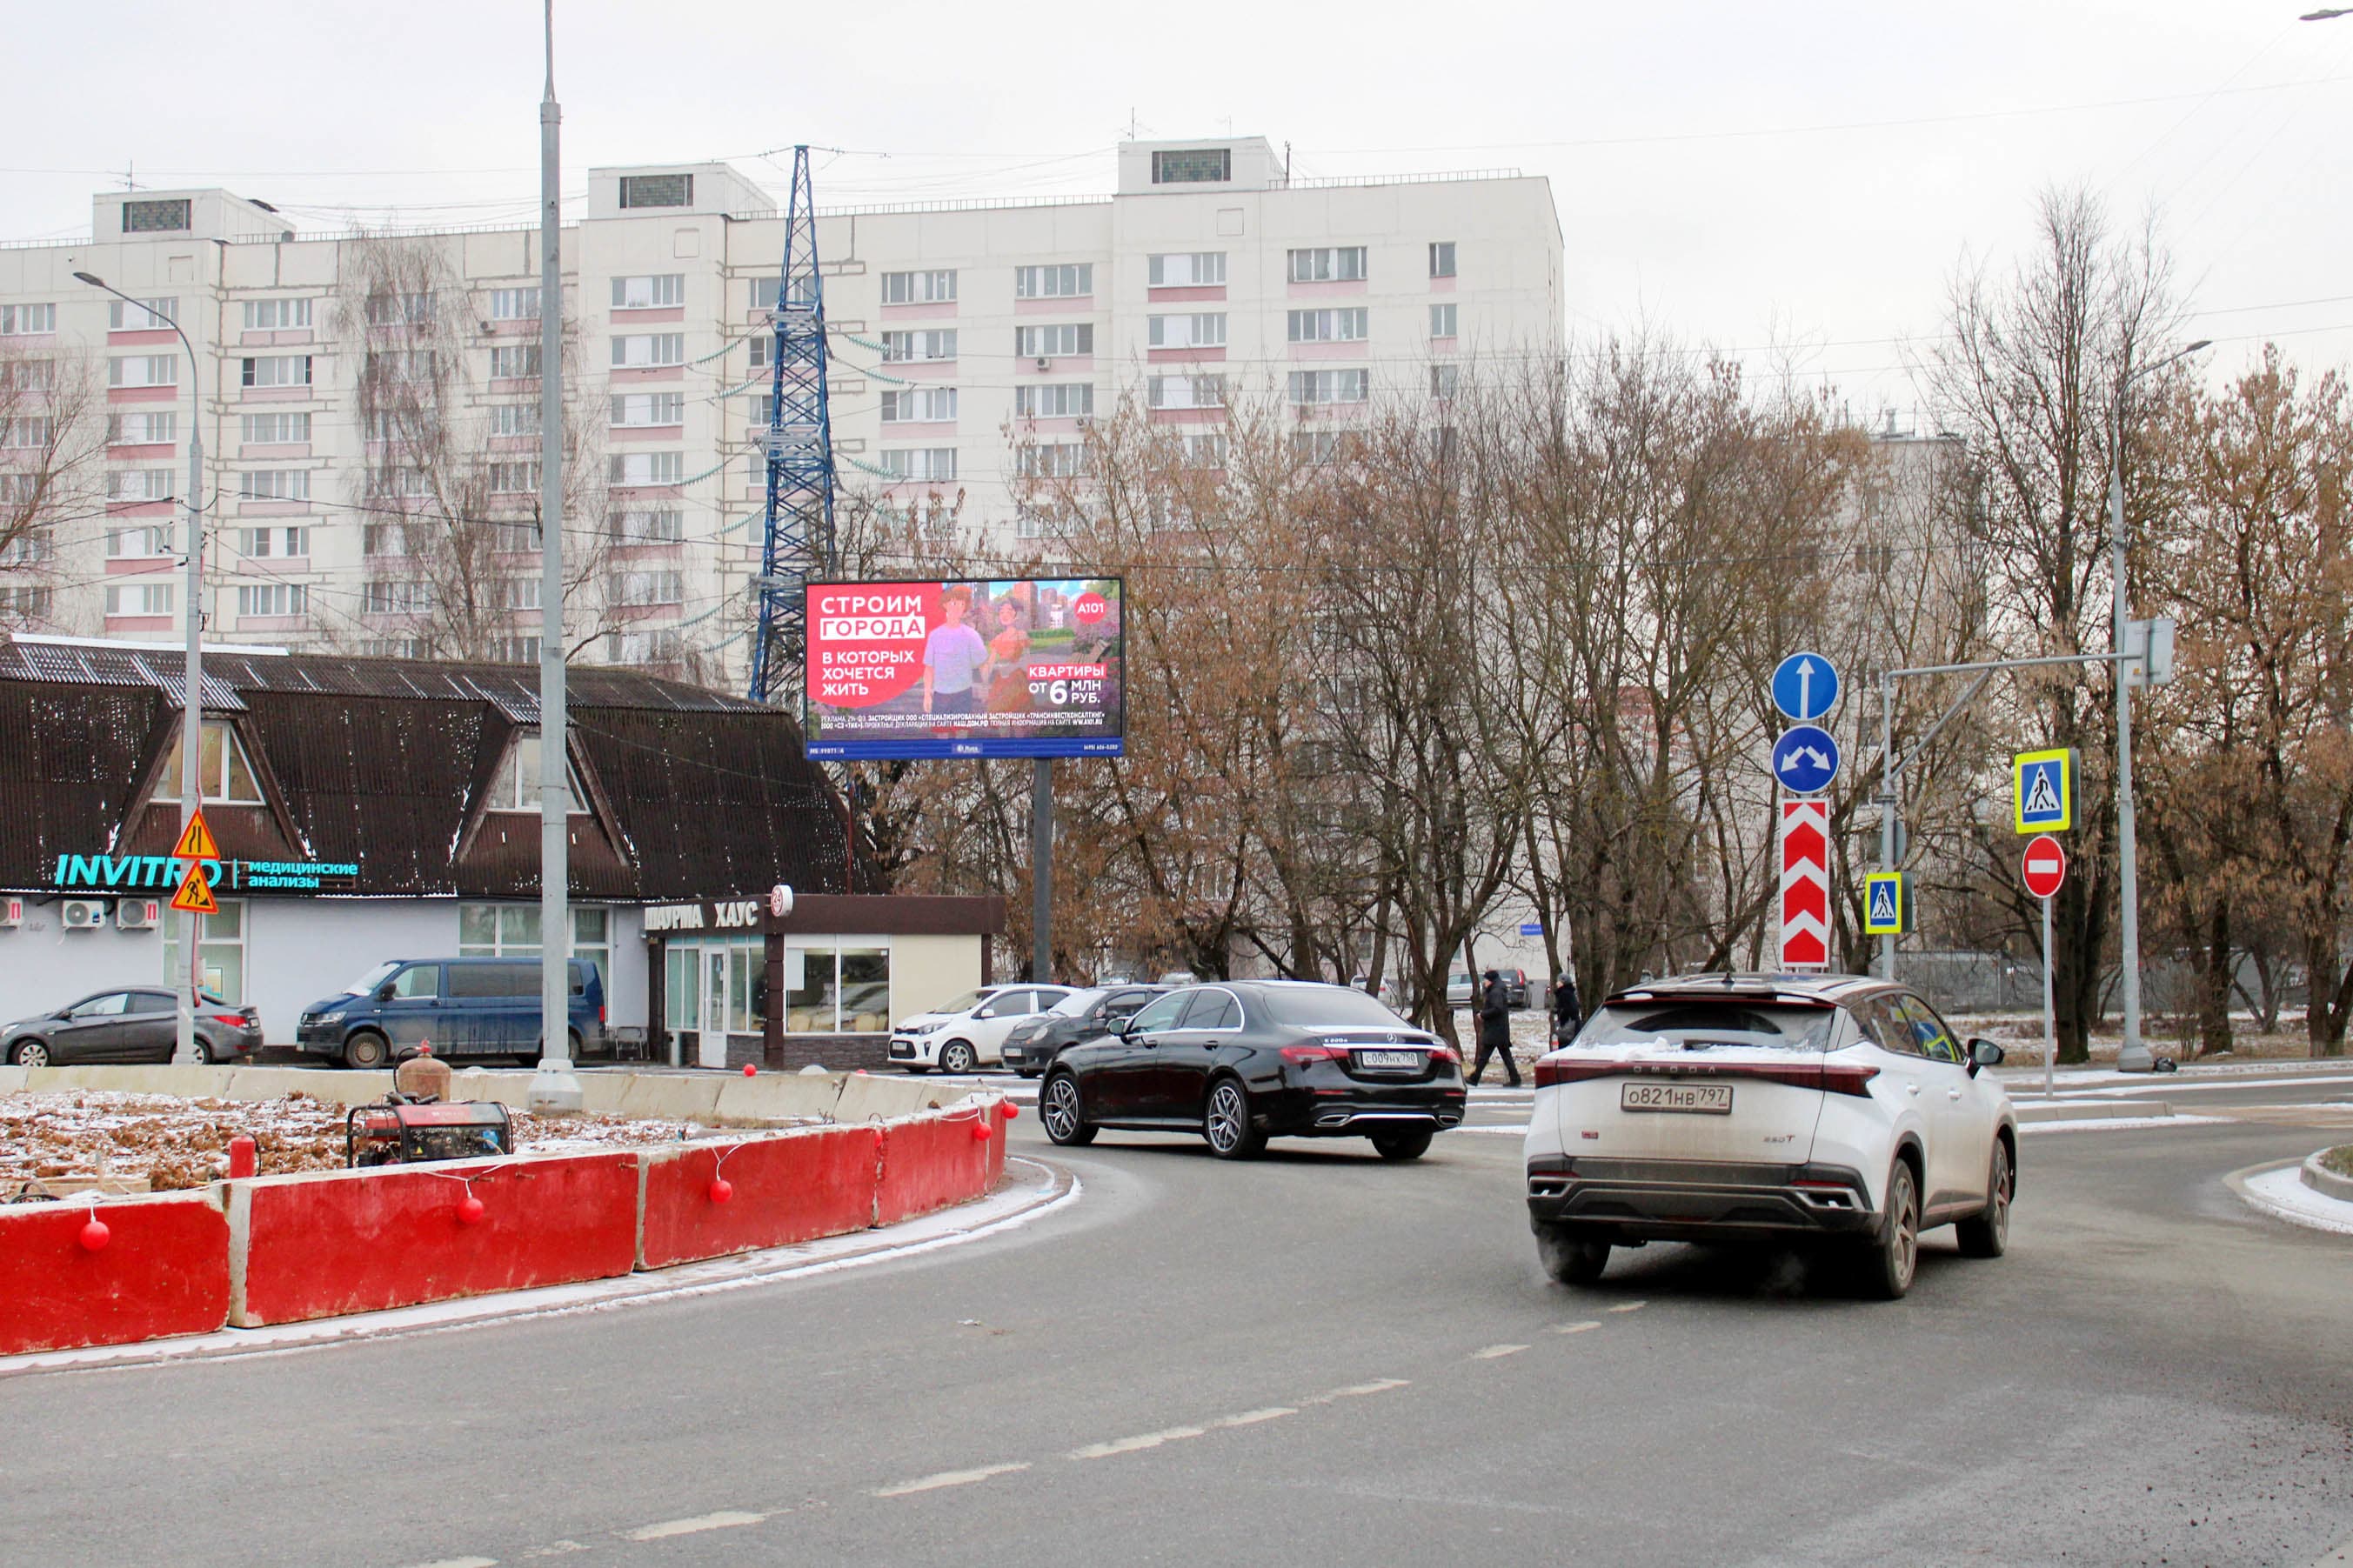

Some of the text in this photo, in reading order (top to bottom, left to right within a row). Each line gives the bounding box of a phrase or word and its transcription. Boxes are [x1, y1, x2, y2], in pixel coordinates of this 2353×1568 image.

[820, 595, 922, 614] СТРОИМ
[821, 619, 922, 637] ГОРОДА
[821, 650, 915, 664] В КОТОРЫХ
[821, 666, 895, 680] ХОЧЕТСЯ
[1029, 665, 1105, 677] КВАРТИРЫ
[821, 683, 869, 696] ЖИТЬ
[1028, 679, 1101, 704] ОТ 6 МЛН
[1071, 692, 1100, 704] РУБ.
[54, 854, 222, 888] INVITRO
[248, 860, 358, 876] медицинские
[248, 876, 320, 889] анализы
[645, 901, 759, 931] ШАУРМА ХАУС
[1633, 1065, 1716, 1074] OMODA
[1699, 1088, 1726, 1103] 797
